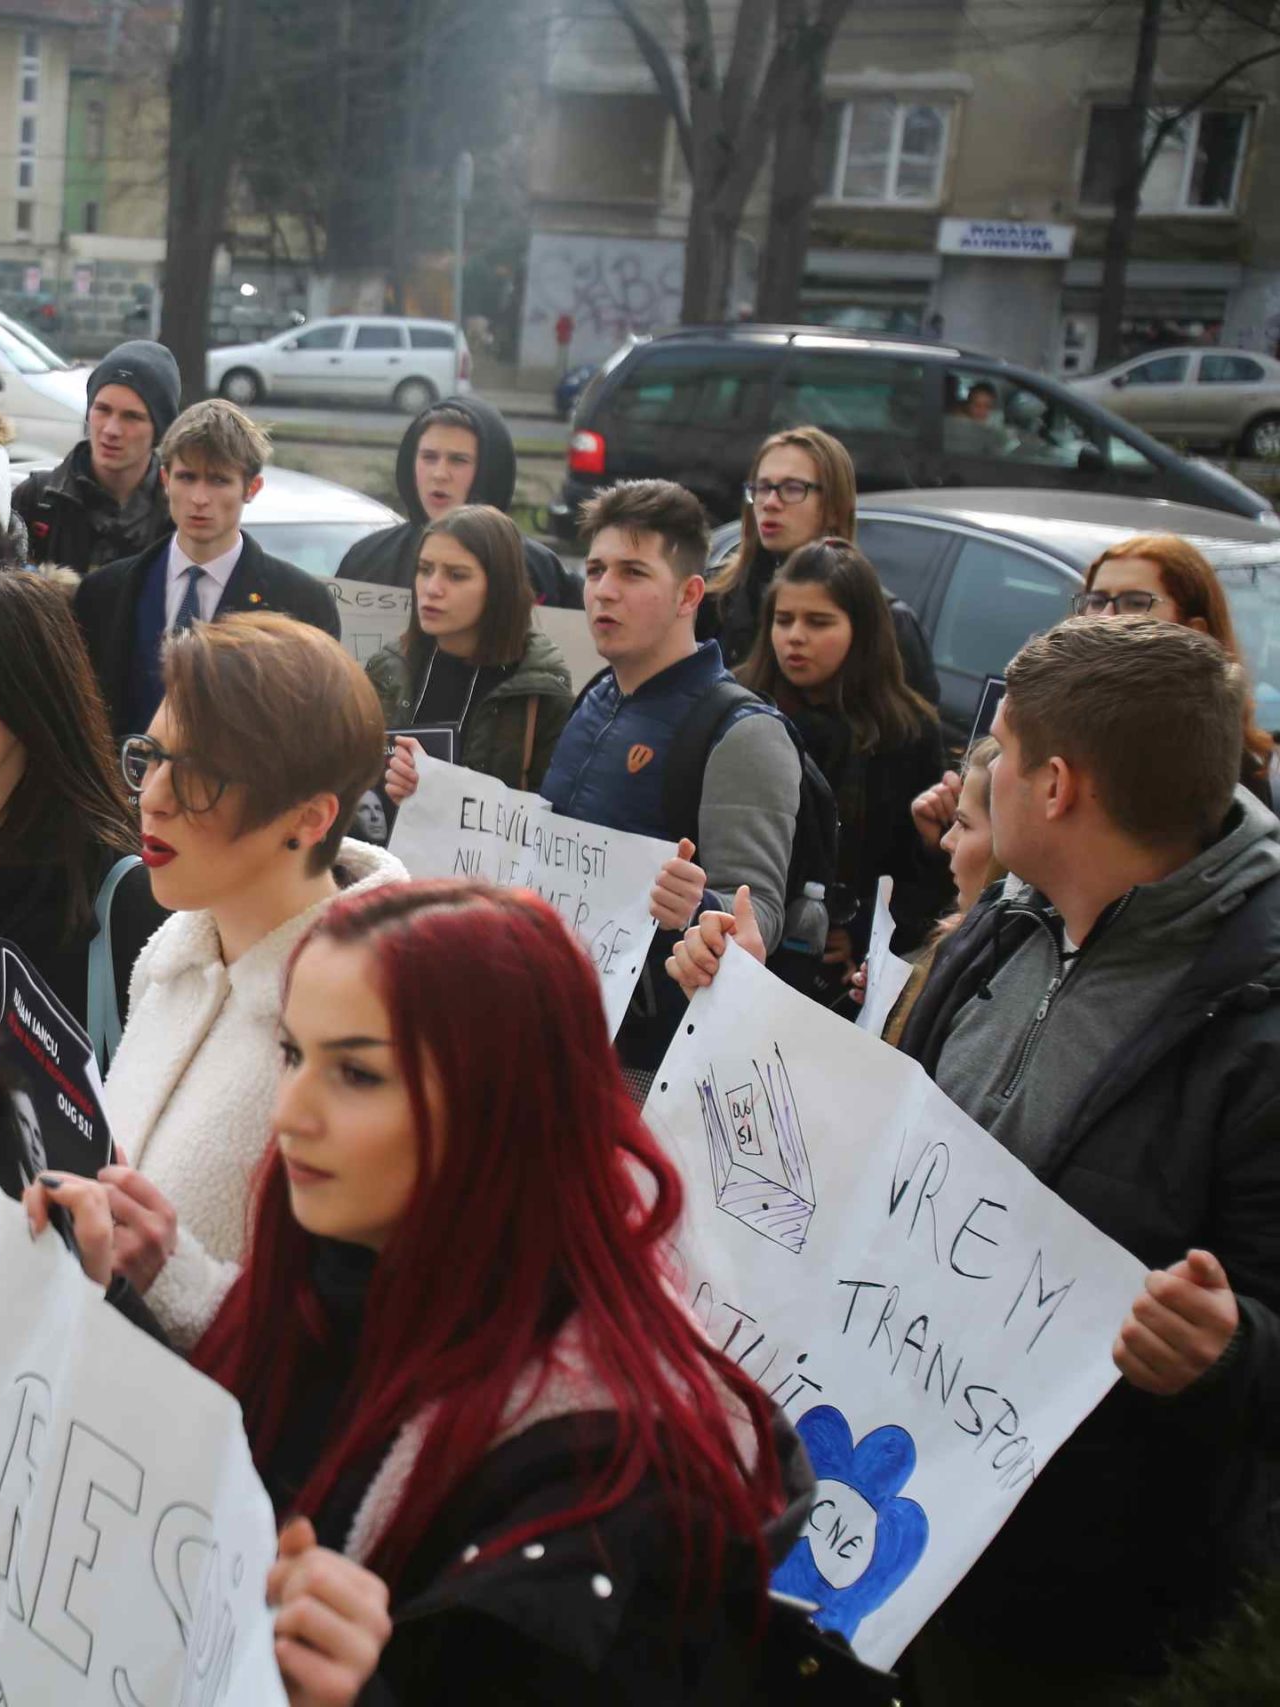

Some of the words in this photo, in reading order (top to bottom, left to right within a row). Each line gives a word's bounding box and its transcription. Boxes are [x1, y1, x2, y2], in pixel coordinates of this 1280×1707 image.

[32, 1017, 61, 1065] IANCU,
[57, 1093, 78, 1124] OUG
[78, 1114, 93, 1141] 51!
[888, 1128, 1076, 1355] VREM
[808, 1499, 863, 1560] CNE
